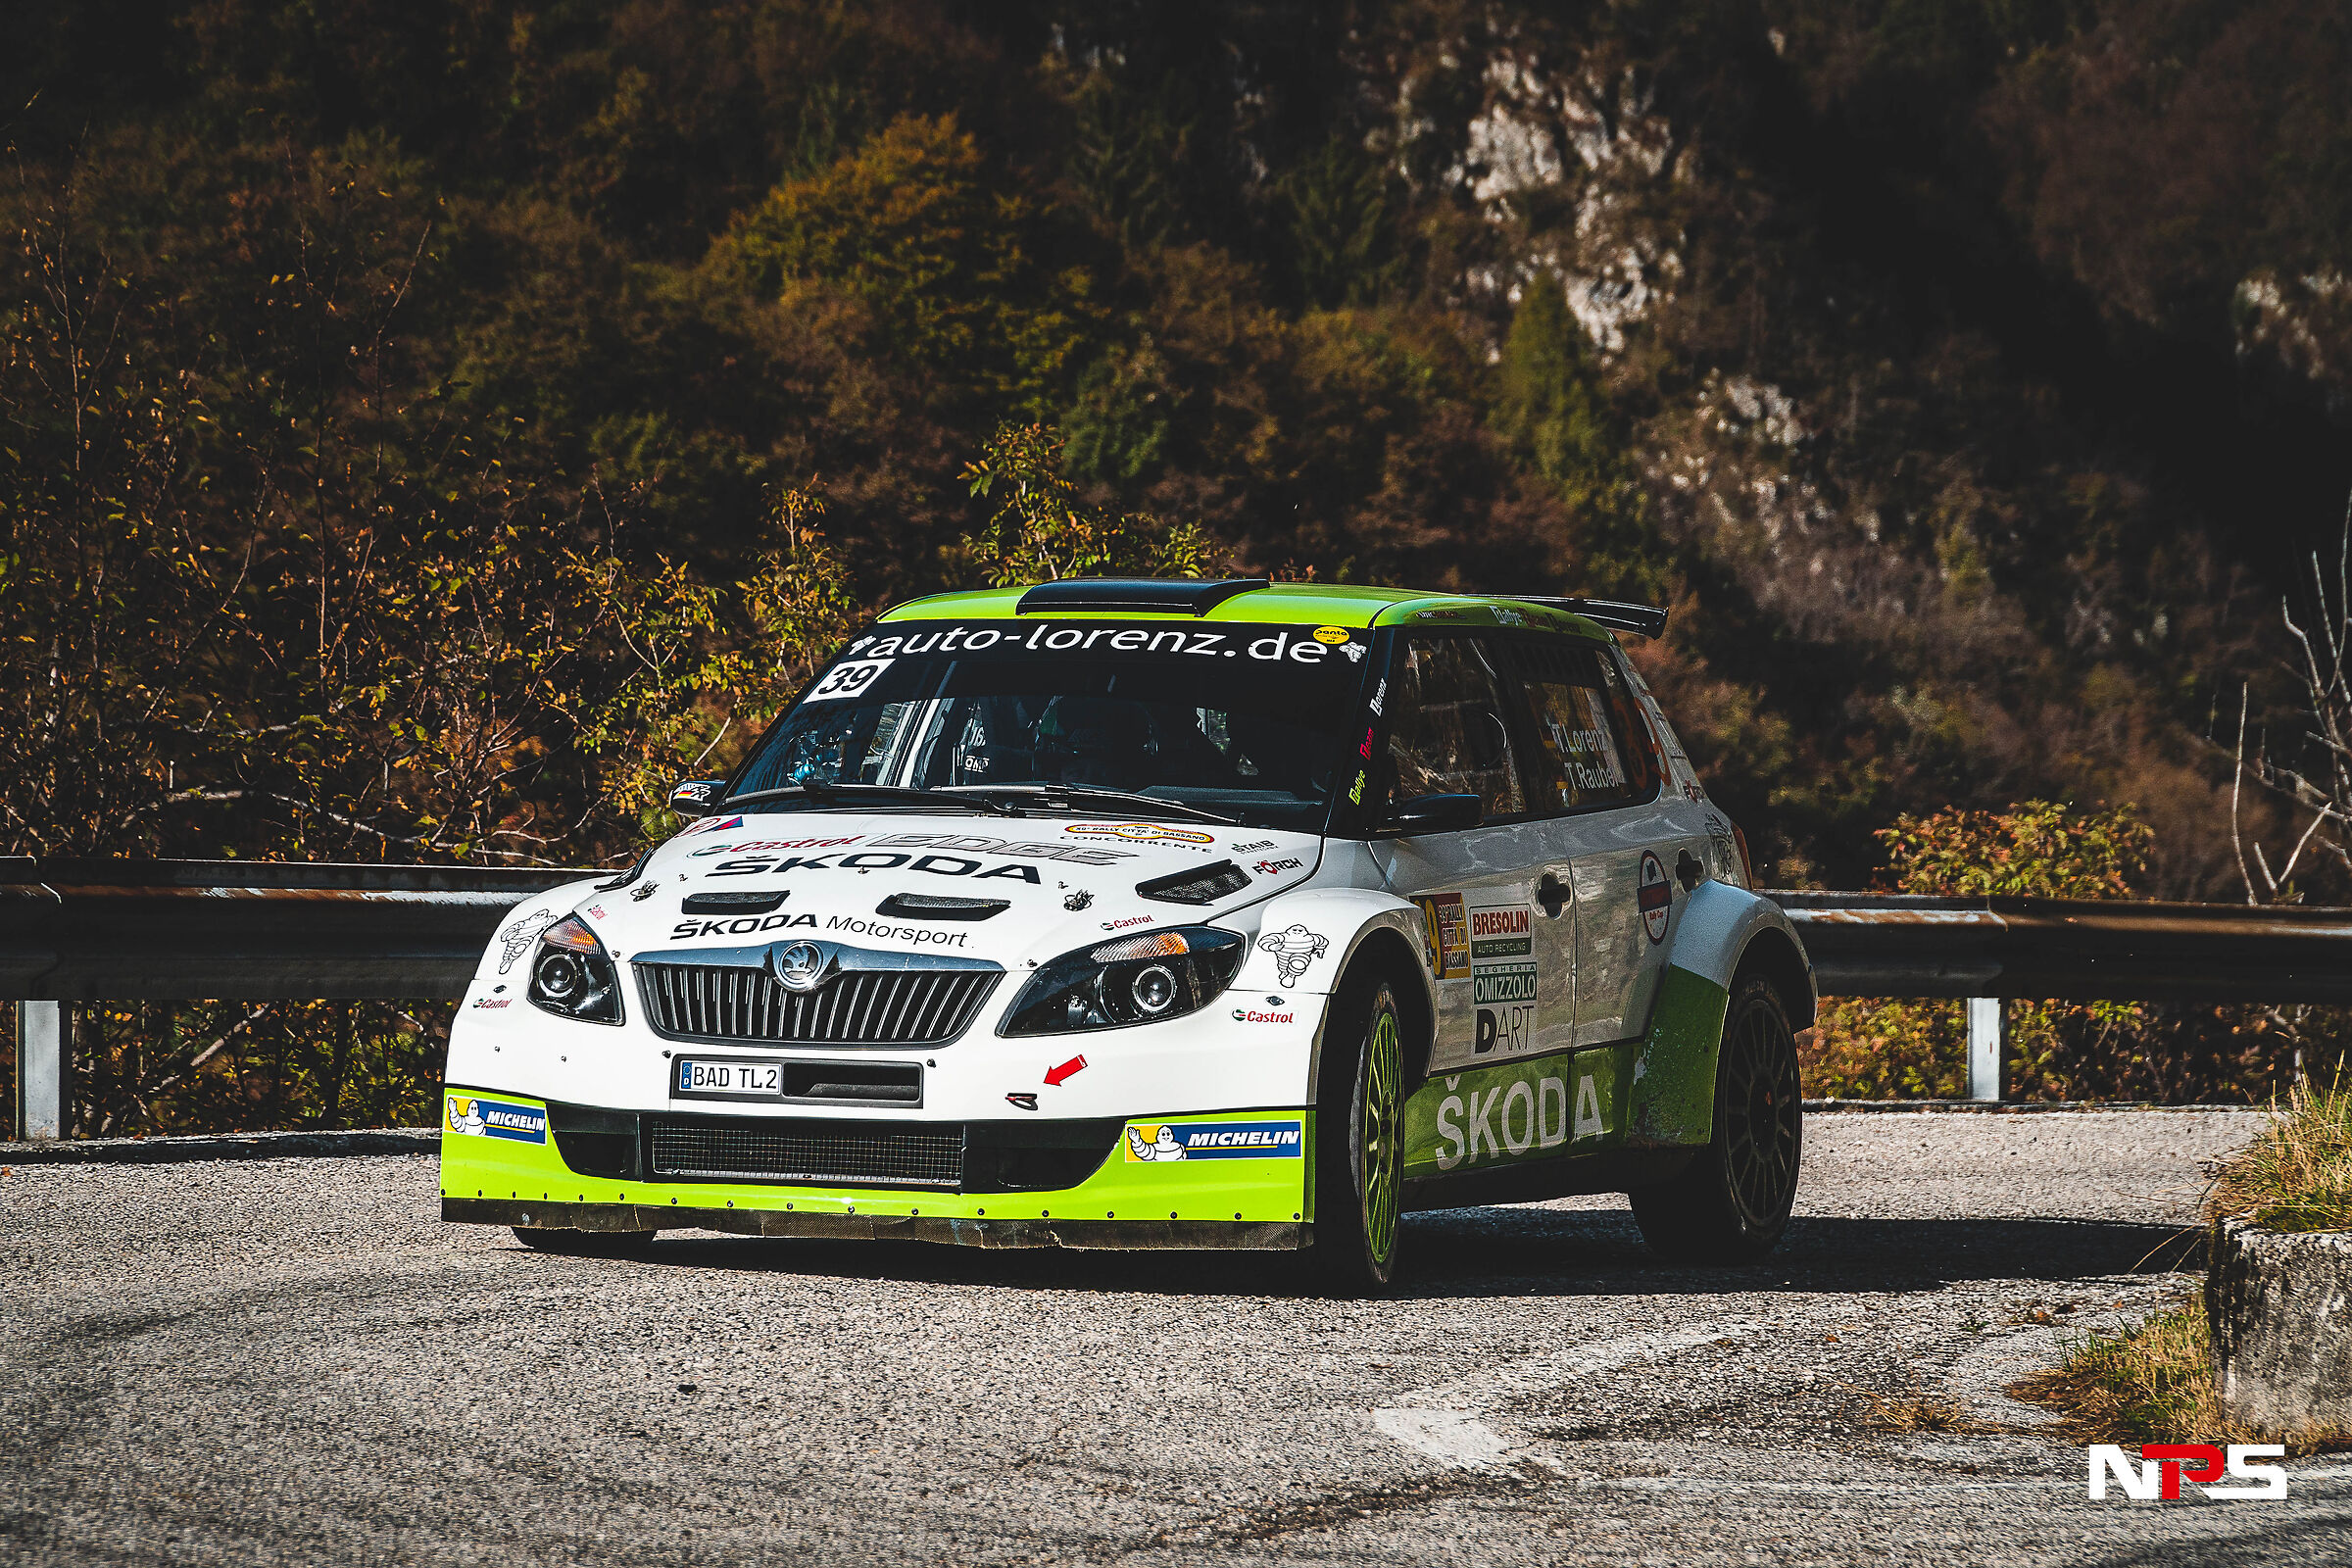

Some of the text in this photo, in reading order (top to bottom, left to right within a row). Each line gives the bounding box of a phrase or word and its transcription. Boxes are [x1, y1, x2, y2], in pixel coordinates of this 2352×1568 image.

[866, 623, 1328, 663] auto-lorenz.de
[818, 664, 878, 694] 39
[730, 833, 1140, 865] Castrol EDGE
[1059, 836, 1212, 854] CONCORRENTE
[705, 853, 1041, 884] ŠKODA
[669, 912, 968, 948] ŠKODA Motorsport
[1113, 914, 1154, 929] Castrol
[1472, 909, 1530, 936] BRESOLIN
[1494, 942, 1526, 952] RECYCLING
[1476, 964, 1535, 974] SEGHERIA
[1475, 974, 1537, 1002] OMIZZOLO
[481, 998, 514, 1009] Castrol
[1247, 1008, 1294, 1024] Castrol
[1475, 1005, 1535, 1054] DART
[694, 1066, 730, 1087] BAD
[486, 1110, 546, 1132] MICHELIN
[1436, 1073, 1605, 1170] ŠKODA
[1188, 1130, 1299, 1147] MICHELIN
